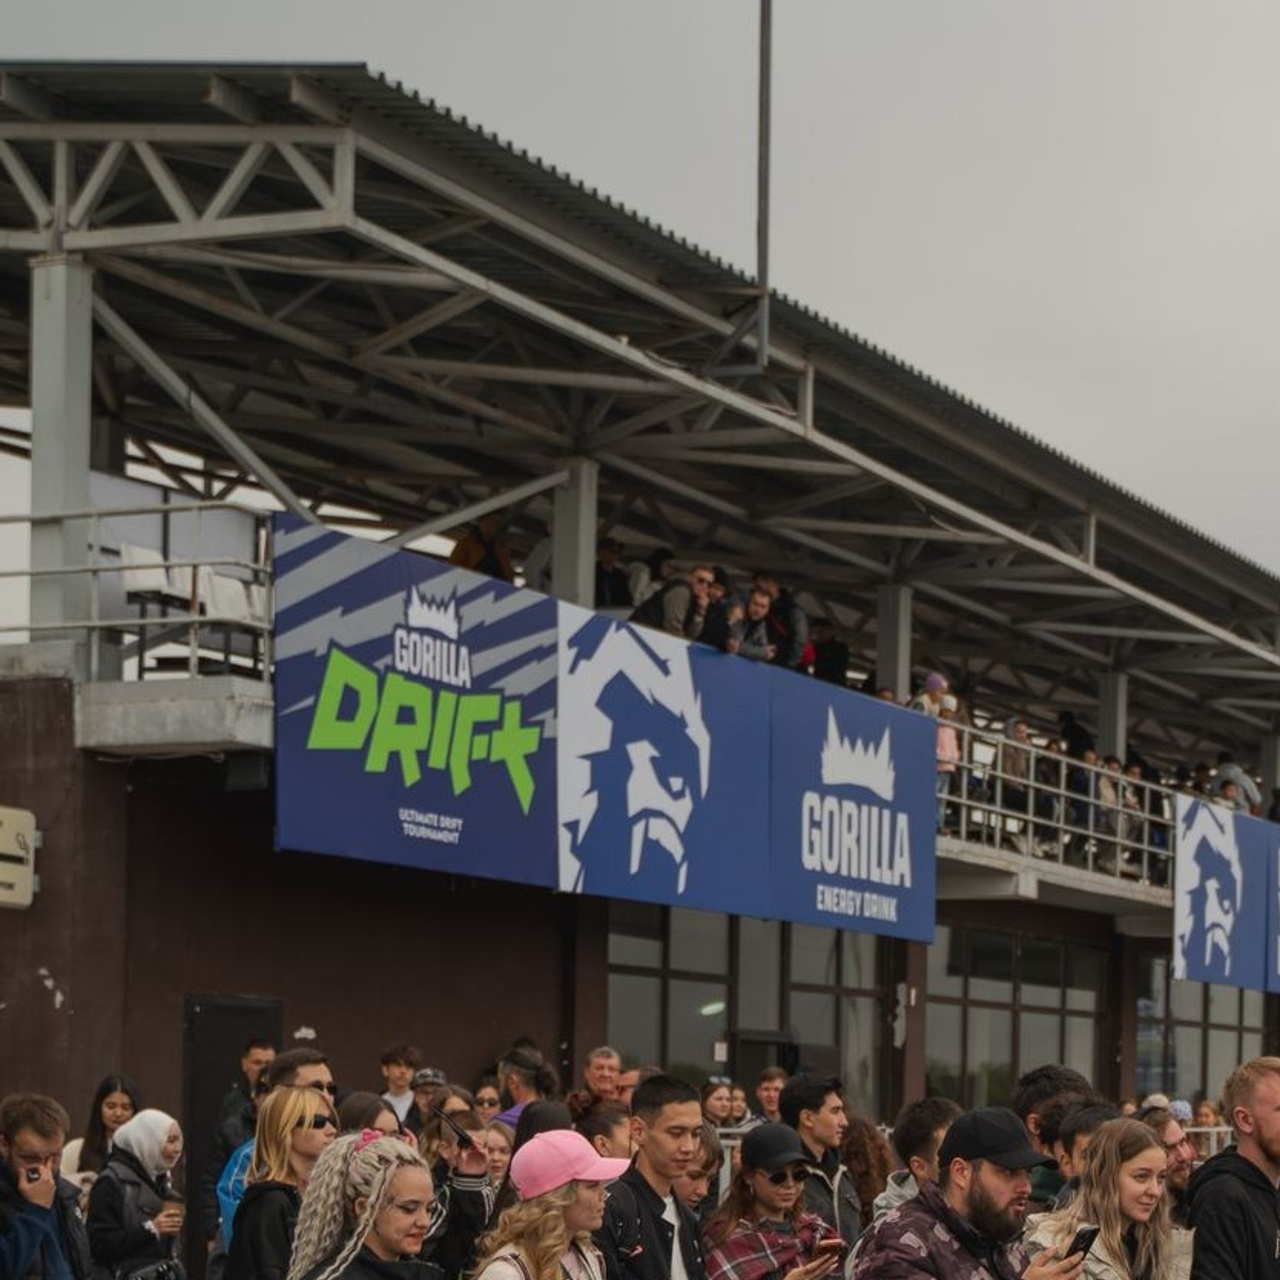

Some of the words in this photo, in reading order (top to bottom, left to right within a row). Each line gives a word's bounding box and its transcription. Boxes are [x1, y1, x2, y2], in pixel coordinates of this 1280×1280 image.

[395, 628, 471, 689] GORILLA
[307, 647, 541, 816] DRIFT
[399, 807, 438, 827] ULTIMATE
[440, 815, 462, 831] DRIFT
[403, 822, 459, 845] TOURNAMENT
[802, 790, 912, 888] GORILLA
[816, 884, 861, 917] ENERGY
[864, 892, 897, 922] DRINK
